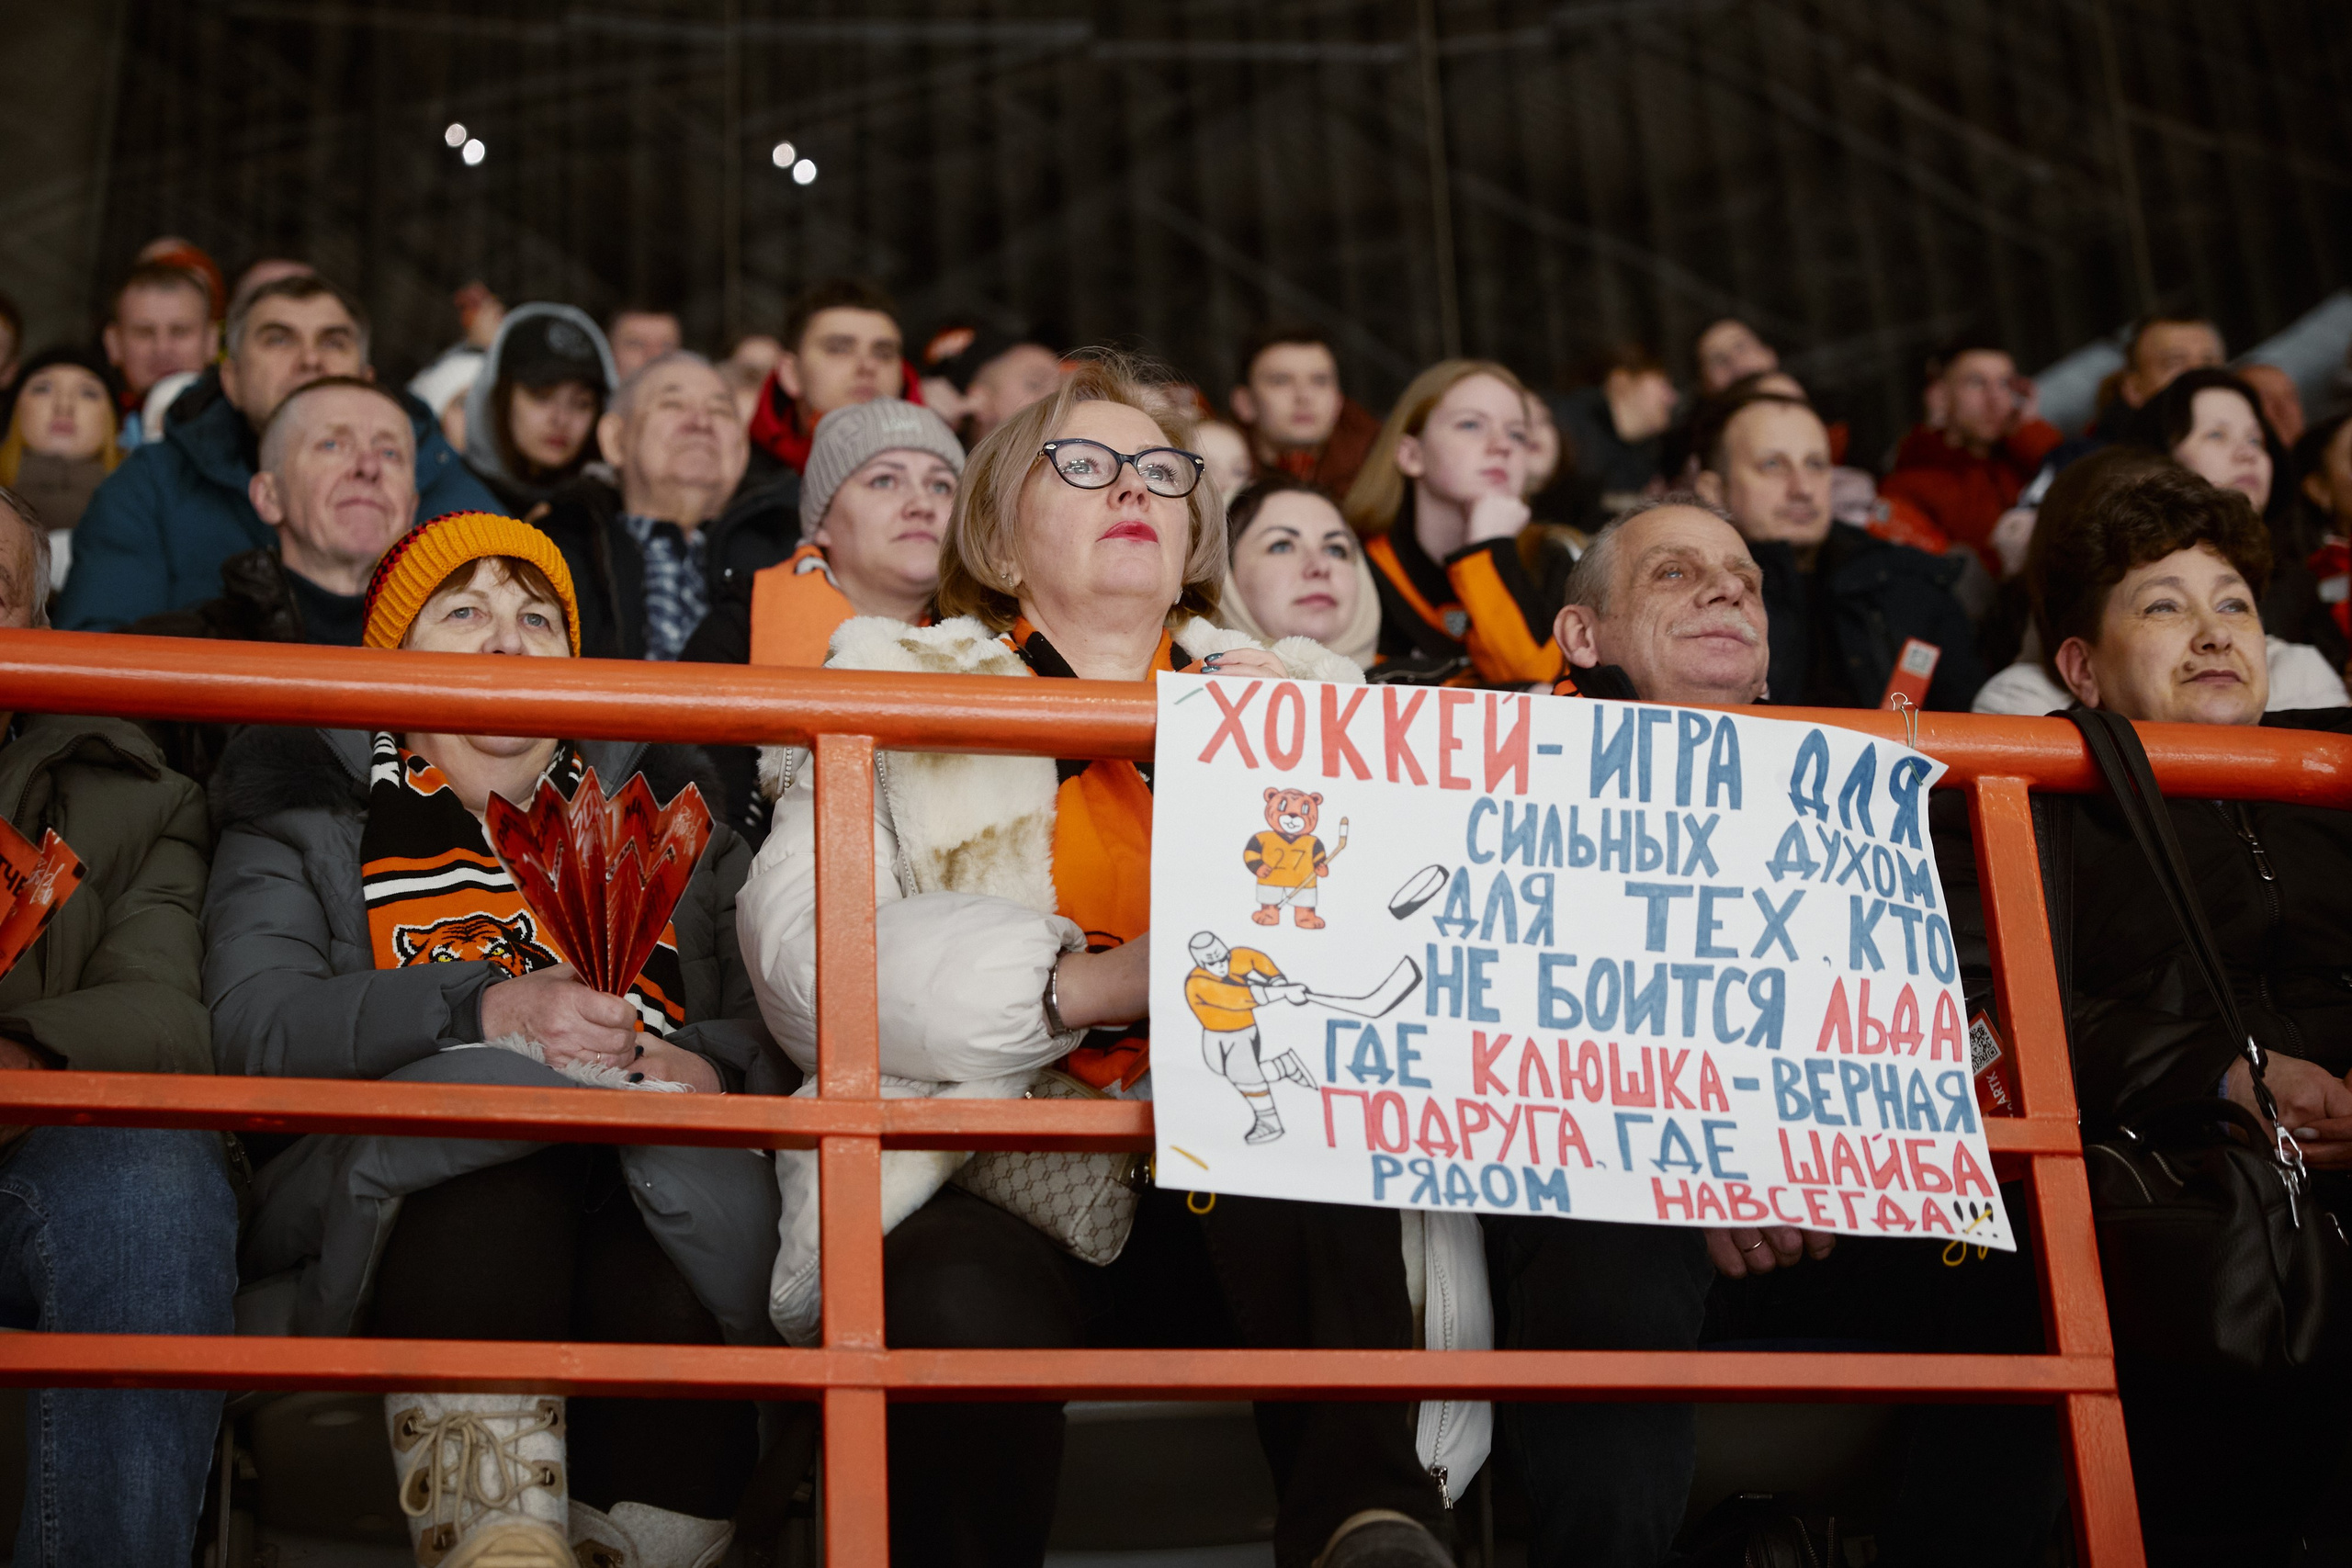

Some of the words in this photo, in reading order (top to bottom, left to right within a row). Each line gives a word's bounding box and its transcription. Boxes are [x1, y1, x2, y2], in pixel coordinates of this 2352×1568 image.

[1589, 704, 1742, 810] ИГРА
[1787, 728, 1933, 851] ДЛЯ
[1272, 847, 1308, 873] 27
[1466, 796, 1721, 878] СИЛЬНЫХ
[1765, 819, 1937, 908] ДУХОМ
[1432, 865, 1555, 947] ДЛЯ
[1849, 894, 1957, 985] КТО
[1425, 942, 1501, 1023] НЕ
[1537, 952, 1786, 1051] БОИТСЯ
[1815, 975, 1963, 1063] ЛЬДА
[1325, 1018, 1432, 1089] ГДЕ
[1771, 1056, 1977, 1134] ВЕРНАЯ
[1371, 1153, 1571, 1213] РЯДОМ
[1651, 1176, 1999, 1238] НАВСЕГДА!!!
[1612, 1111, 1748, 1180] ГДЕ
[1778, 1127, 1995, 1197] ШАЙБА
